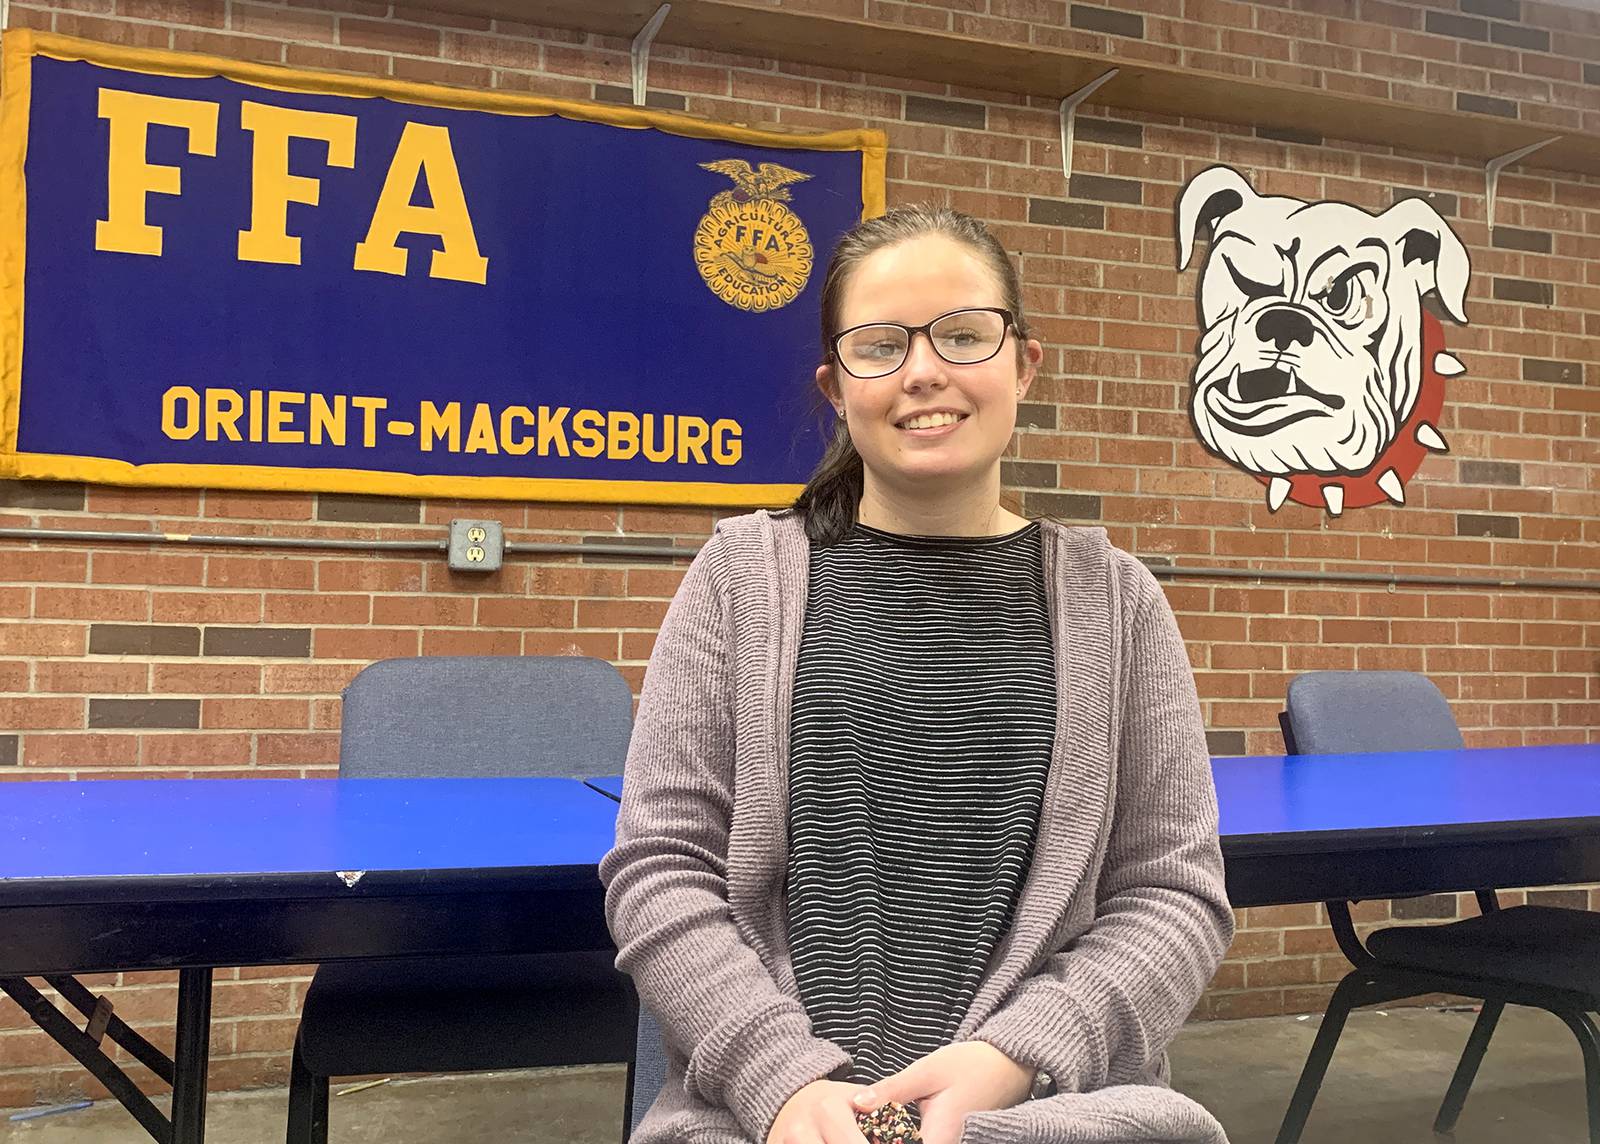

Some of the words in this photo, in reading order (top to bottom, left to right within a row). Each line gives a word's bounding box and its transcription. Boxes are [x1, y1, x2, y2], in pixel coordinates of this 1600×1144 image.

[95, 87, 488, 284] FFA
[714, 212, 795, 257] AGRICULTURAL
[735, 226, 780, 252] FFA
[718, 267, 788, 295] EDUCATION
[161, 386, 743, 466] ORIENT-MACKSBURG
